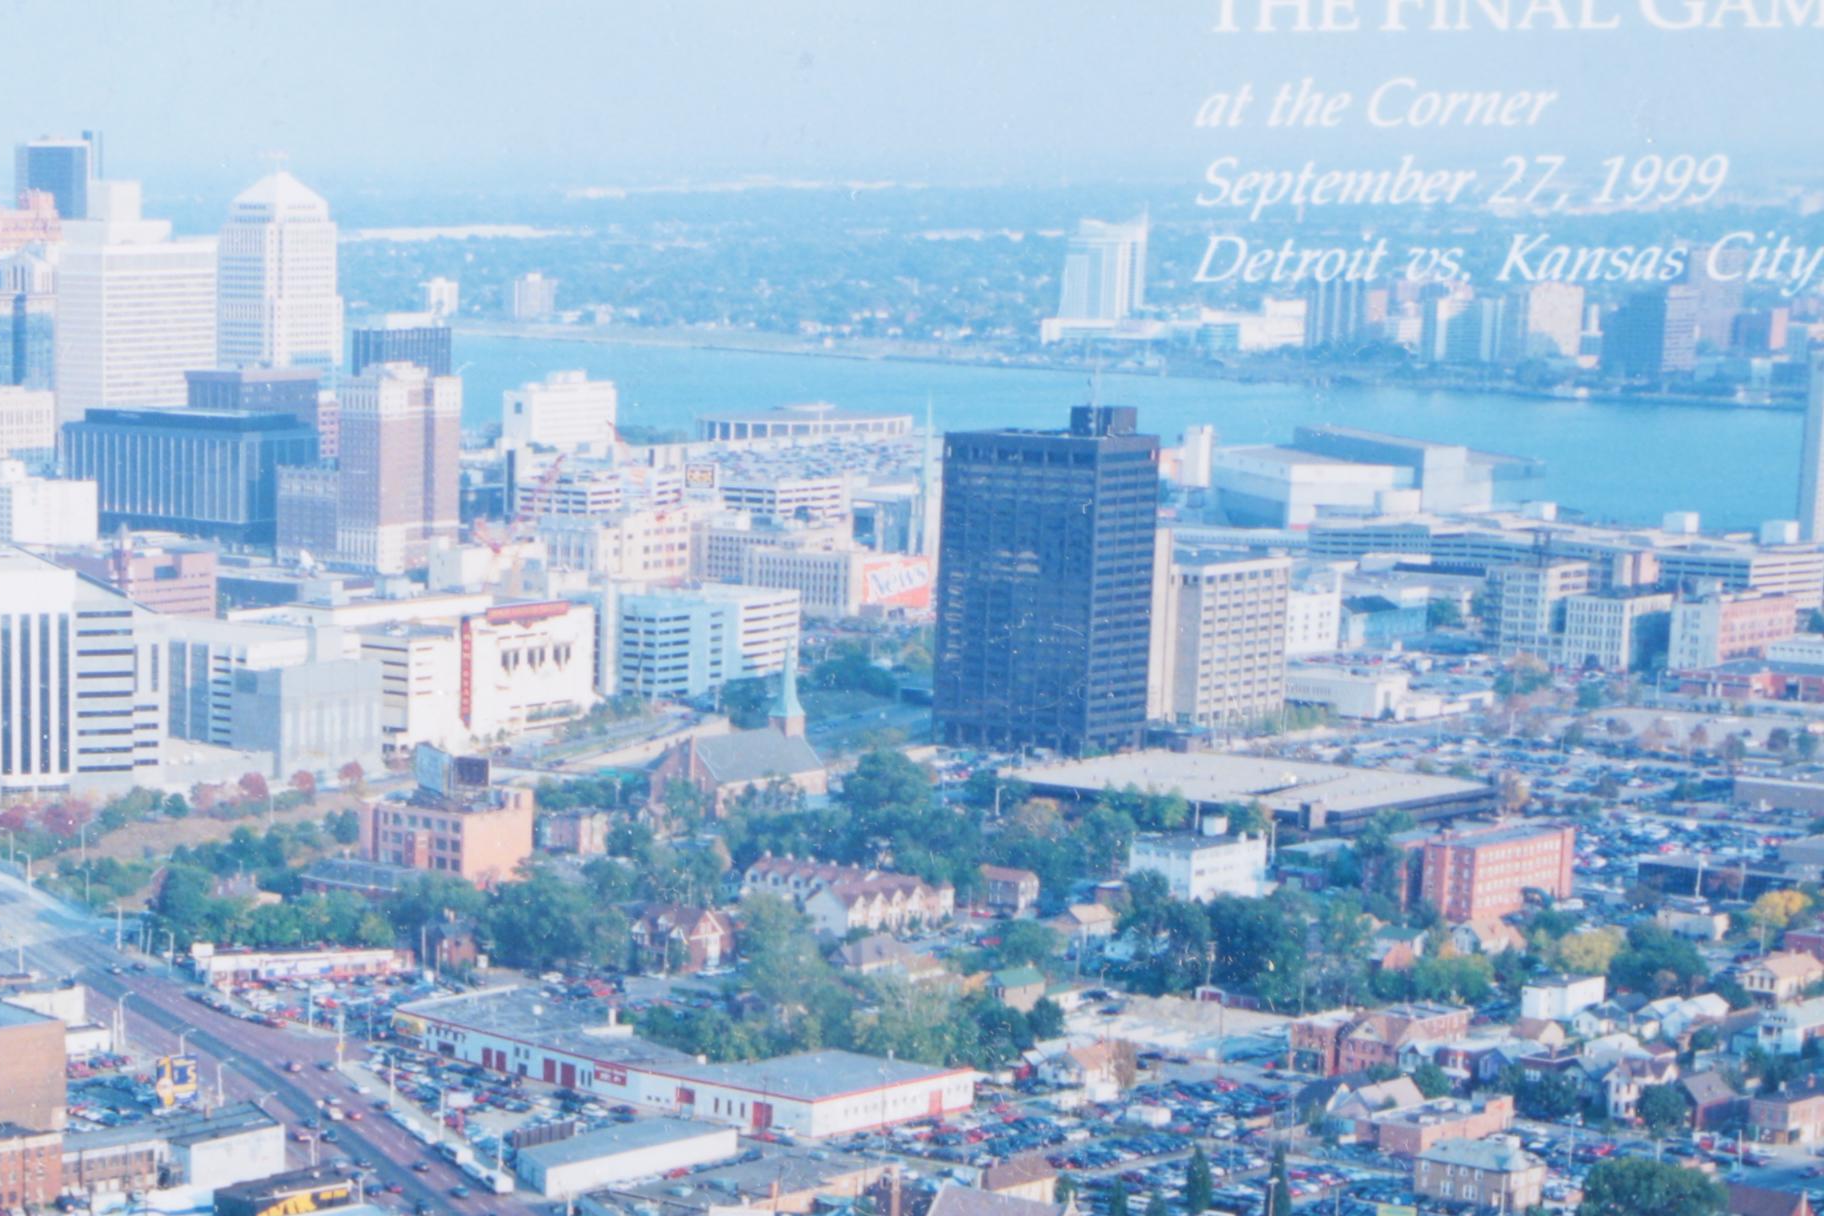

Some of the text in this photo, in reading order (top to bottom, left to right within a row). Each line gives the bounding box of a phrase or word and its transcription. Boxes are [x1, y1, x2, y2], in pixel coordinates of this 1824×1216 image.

[1194, 77, 1559, 127] at the Corner
[1195, 154, 1730, 221] September 27, 1999
[1192, 230, 1824, 298] Detroit vs. Kansas City
